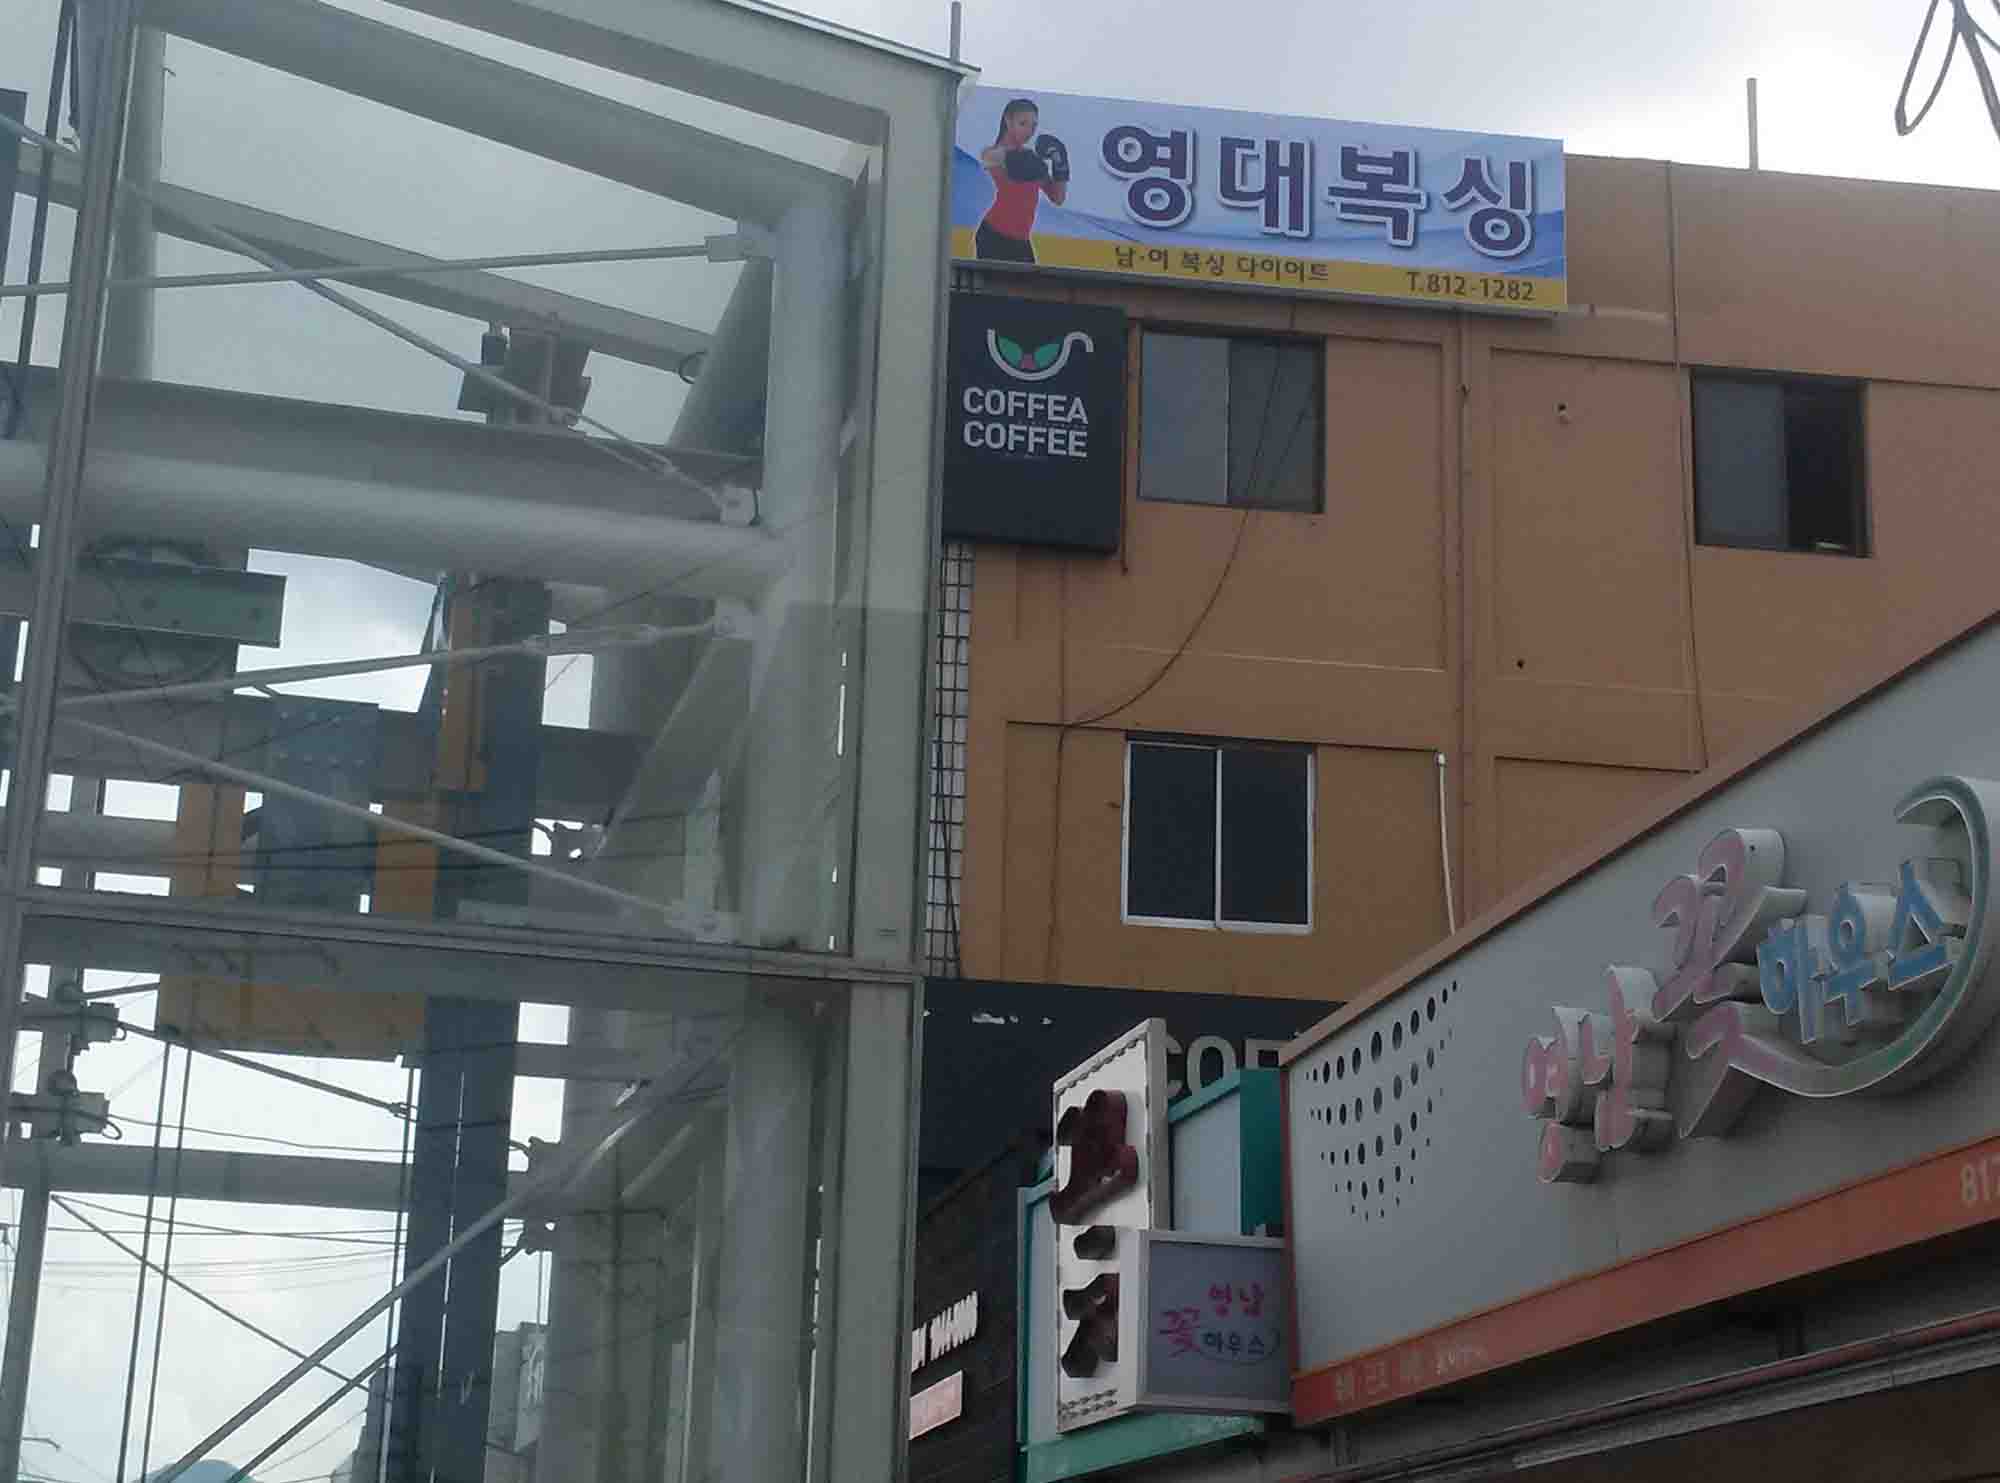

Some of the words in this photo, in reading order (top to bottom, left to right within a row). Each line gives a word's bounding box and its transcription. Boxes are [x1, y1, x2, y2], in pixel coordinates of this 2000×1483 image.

[1103, 125, 1536, 257] 영대복싱
[1182, 250, 1226, 277] 복싱
[1237, 255, 1330, 284] 다이어트
[1407, 270, 1537, 301] T.812-1282
[963, 386, 1088, 425] COFFEA
[963, 421, 1088, 457] COFFEE
[1757, 862, 1956, 1044] 하우스
